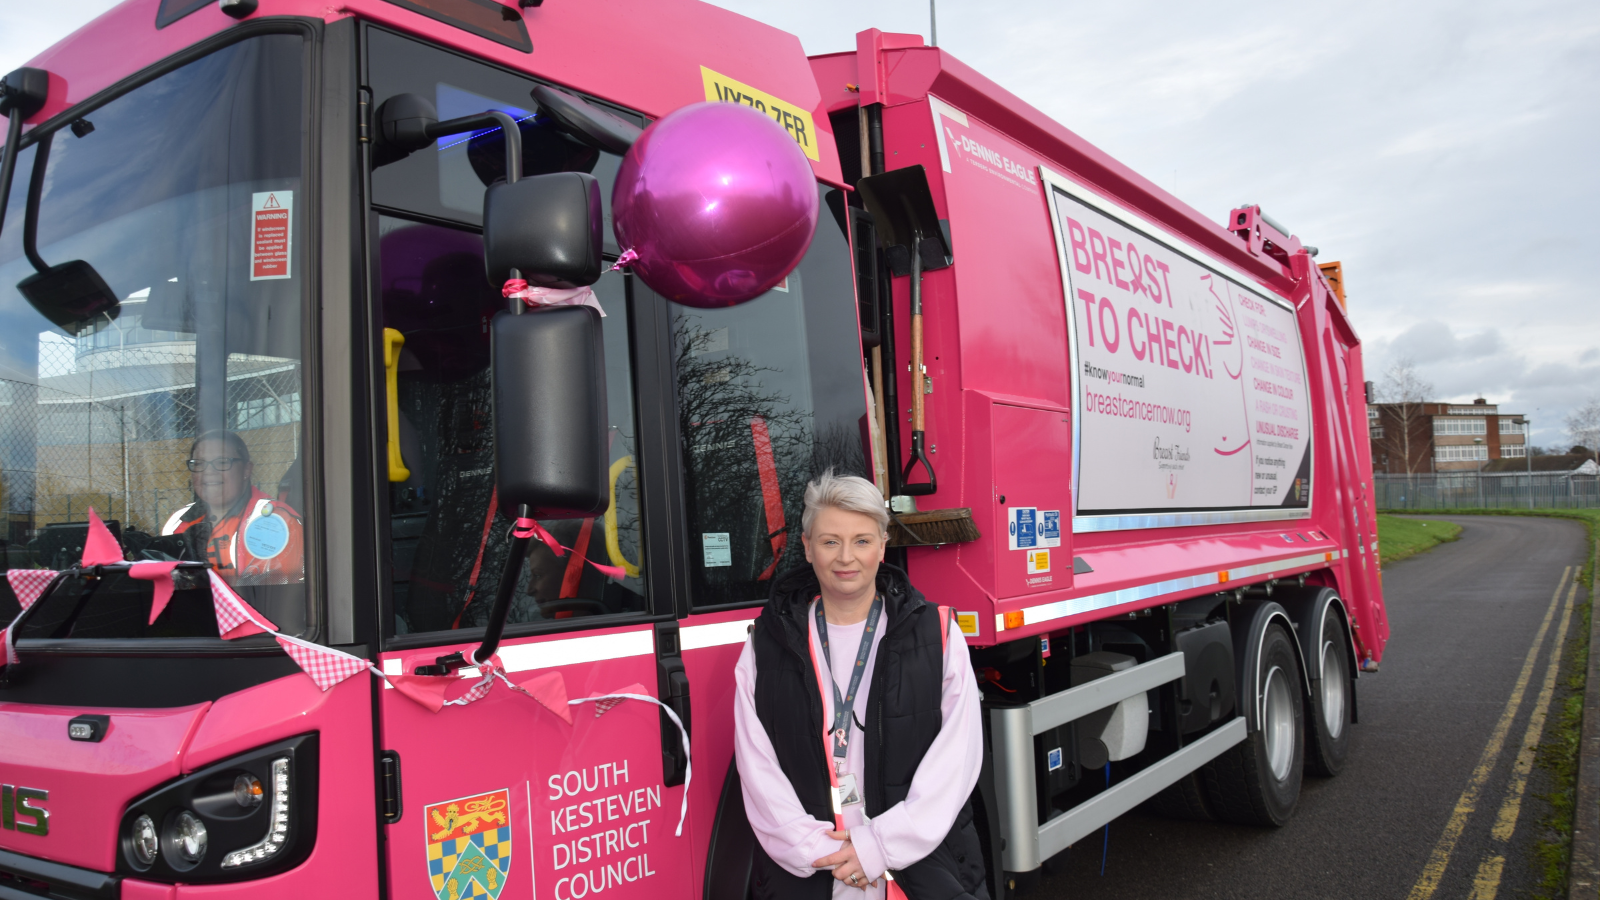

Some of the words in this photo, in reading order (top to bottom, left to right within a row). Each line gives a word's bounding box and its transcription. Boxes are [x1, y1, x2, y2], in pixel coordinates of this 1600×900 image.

[961, 135, 1003, 169] DENNIS
[1003, 157, 1036, 185] EAGLE
[1238, 294, 1254, 311] CHECK
[1077, 288, 1120, 354] TO
[1127, 307, 1213, 379] CHECK!
[1247, 335, 1266, 353] CHANGE
[1267, 342, 1272, 354] IN
[1272, 345, 1281, 359] SIZE
[1085, 361, 1144, 388] #knowyournormal
[1251, 356, 1270, 374] CHANGE
[1254, 378, 1272, 394] CHANGE
[1277, 385, 1293, 400] COLOUR
[1086, 385, 1190, 433] breastcancernow.org
[1256, 420, 1276, 436] UNUSUAL
[1277, 424, 1299, 440] DISCHARGE
[460, 467, 492, 478] DENNIS
[1265, 457, 1274, 465] notice
[1274, 458, 1286, 468] anything
[1254, 486, 1265, 494] contact
[548, 760, 628, 800] SOUTH
[551, 785, 661, 835] KESTEVEN
[553, 820, 650, 870] DISTRICT
[555, 854, 655, 900] COUNCIL
